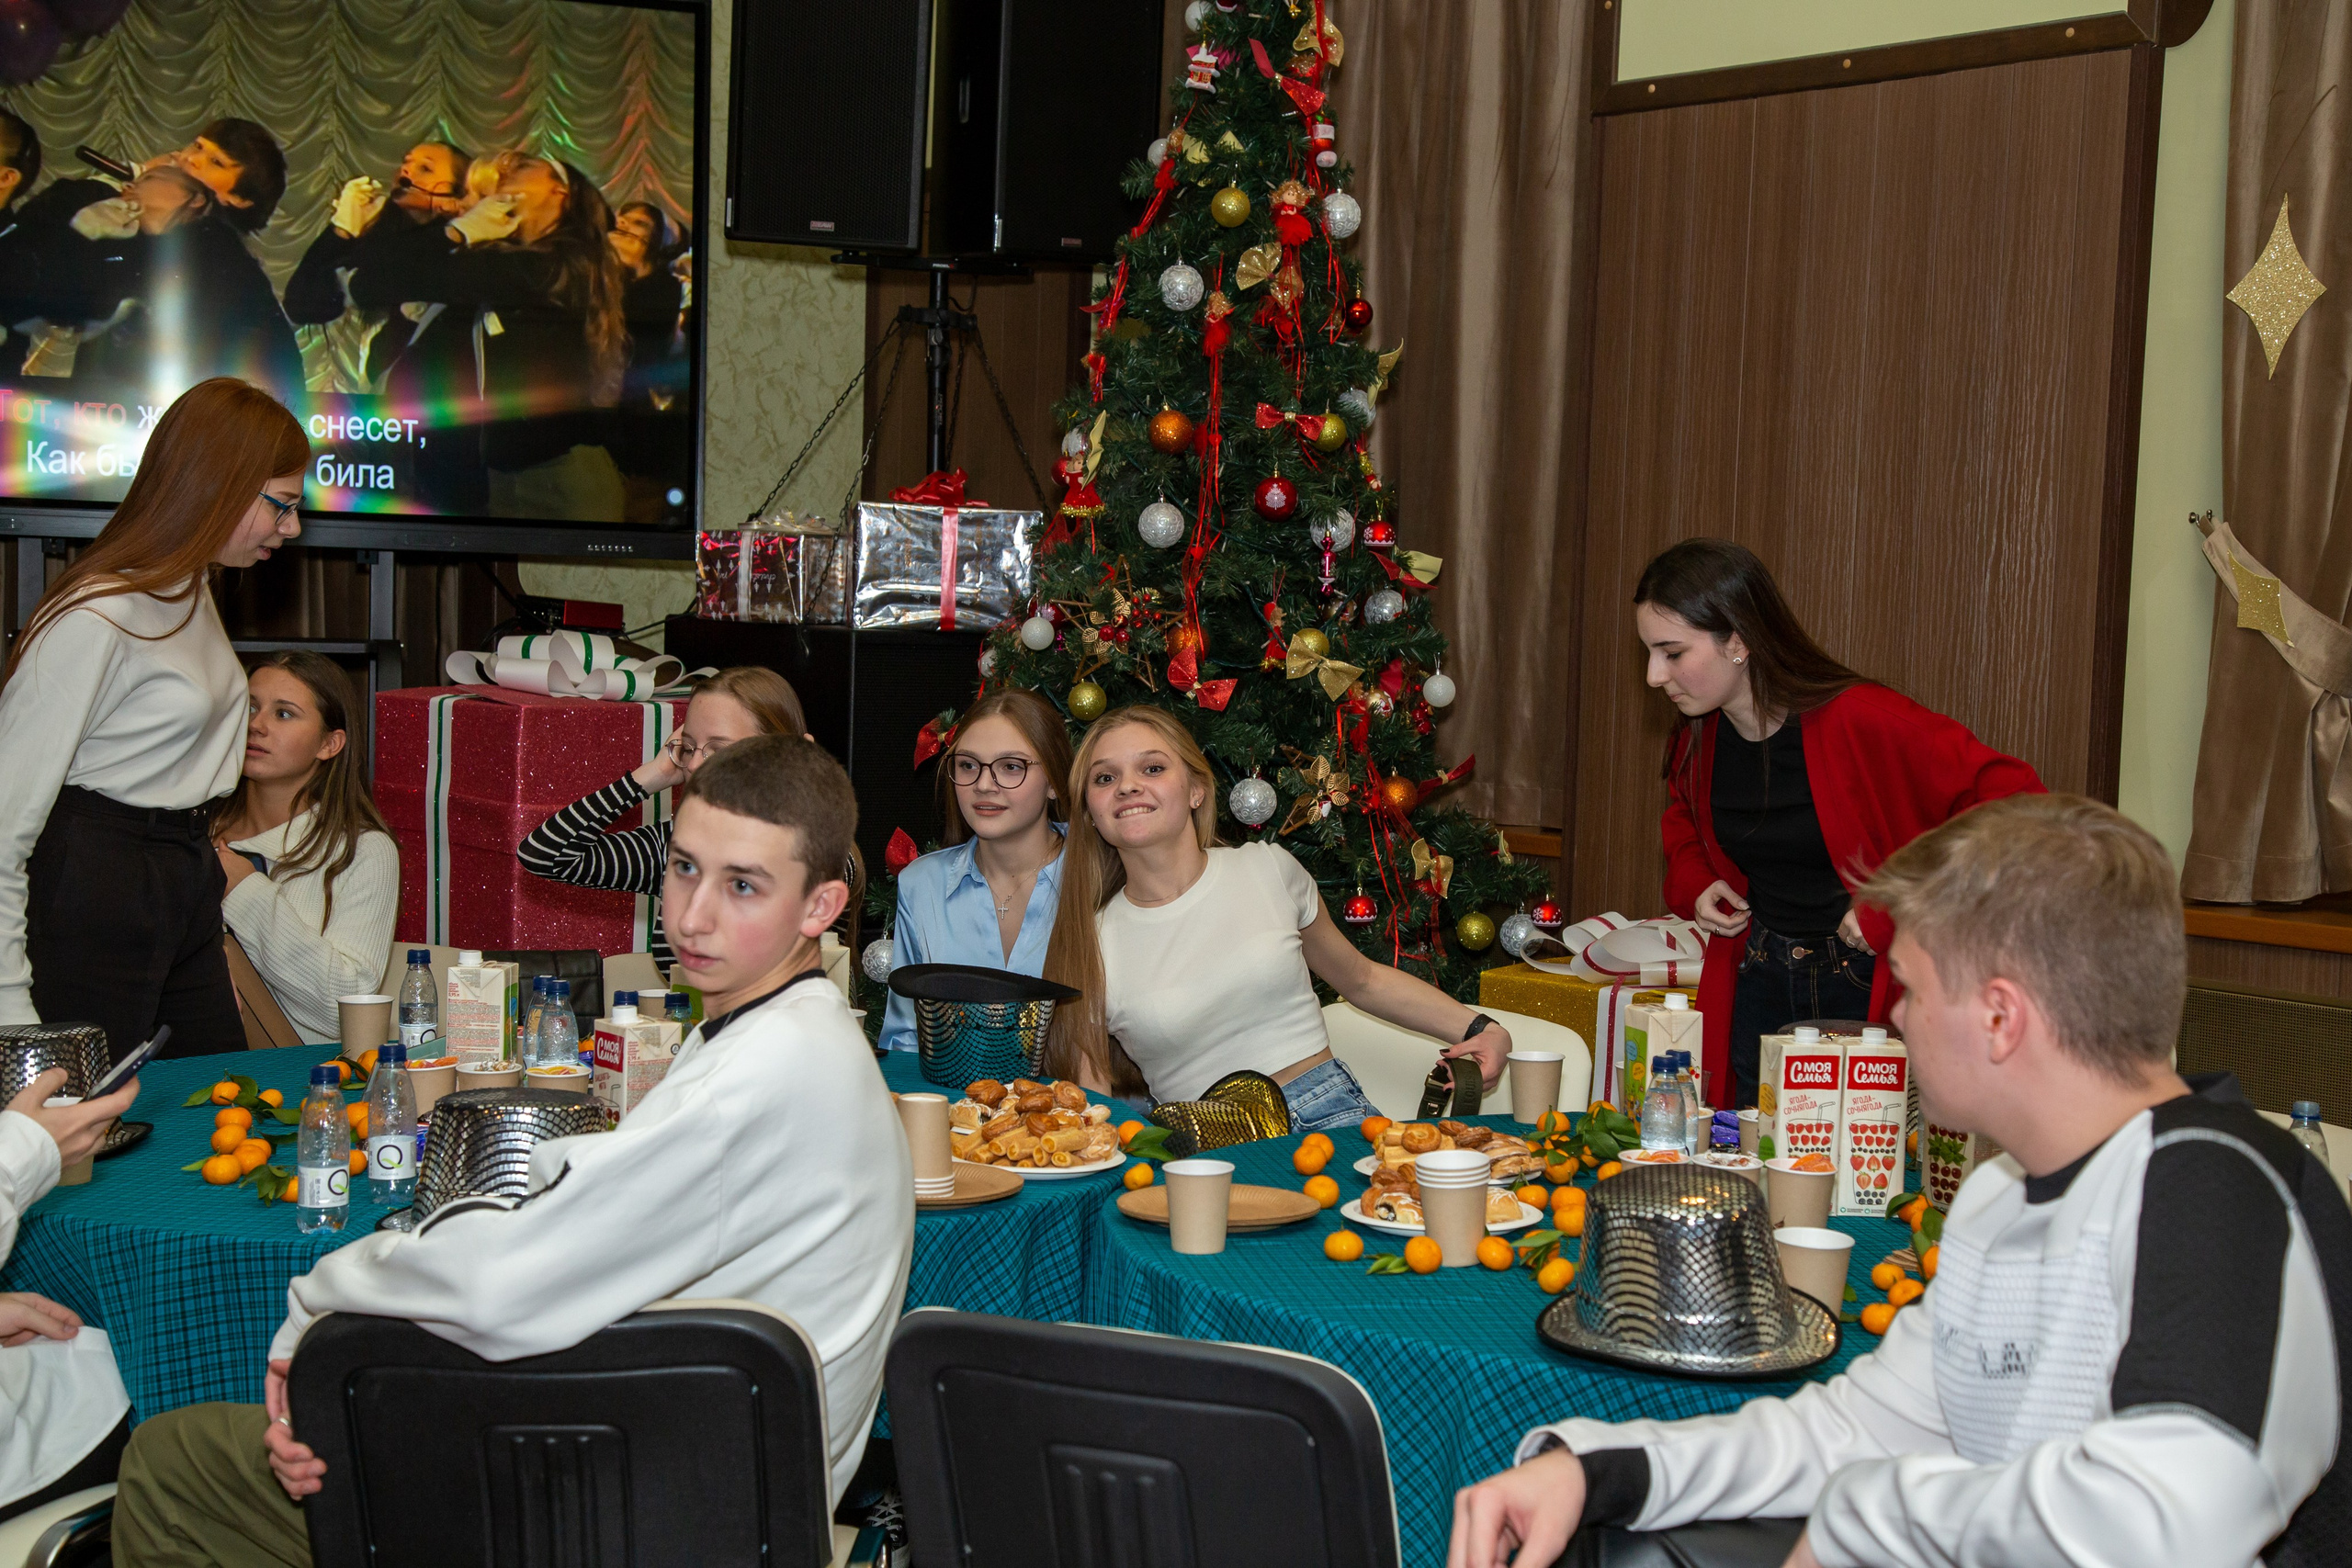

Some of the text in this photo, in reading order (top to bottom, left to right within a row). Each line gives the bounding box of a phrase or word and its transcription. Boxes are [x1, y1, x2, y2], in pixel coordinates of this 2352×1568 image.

[74, 401, 127, 428] кто
[309, 414, 426, 449] снесет,
[27, 440, 85, 476] Как
[316, 454, 395, 490] била
[597, 1037, 620, 1065] Семья
[604, 1040, 619, 1054] МОЯ
[1790, 1061, 1833, 1083] Семья
[1804, 1062, 1832, 1073] МОЯ
[1853, 1062, 1898, 1085] Семья
[1868, 1063, 1897, 1075] МОЯ
[1789, 1094, 1812, 1105] ЯГОДА-
[1852, 1094, 1876, 1105] ЯГОДА-
[1783, 1100, 1818, 1115] СОЧНЯГОДА
[1847, 1101, 1883, 1115] СОЧНЯГОДА
